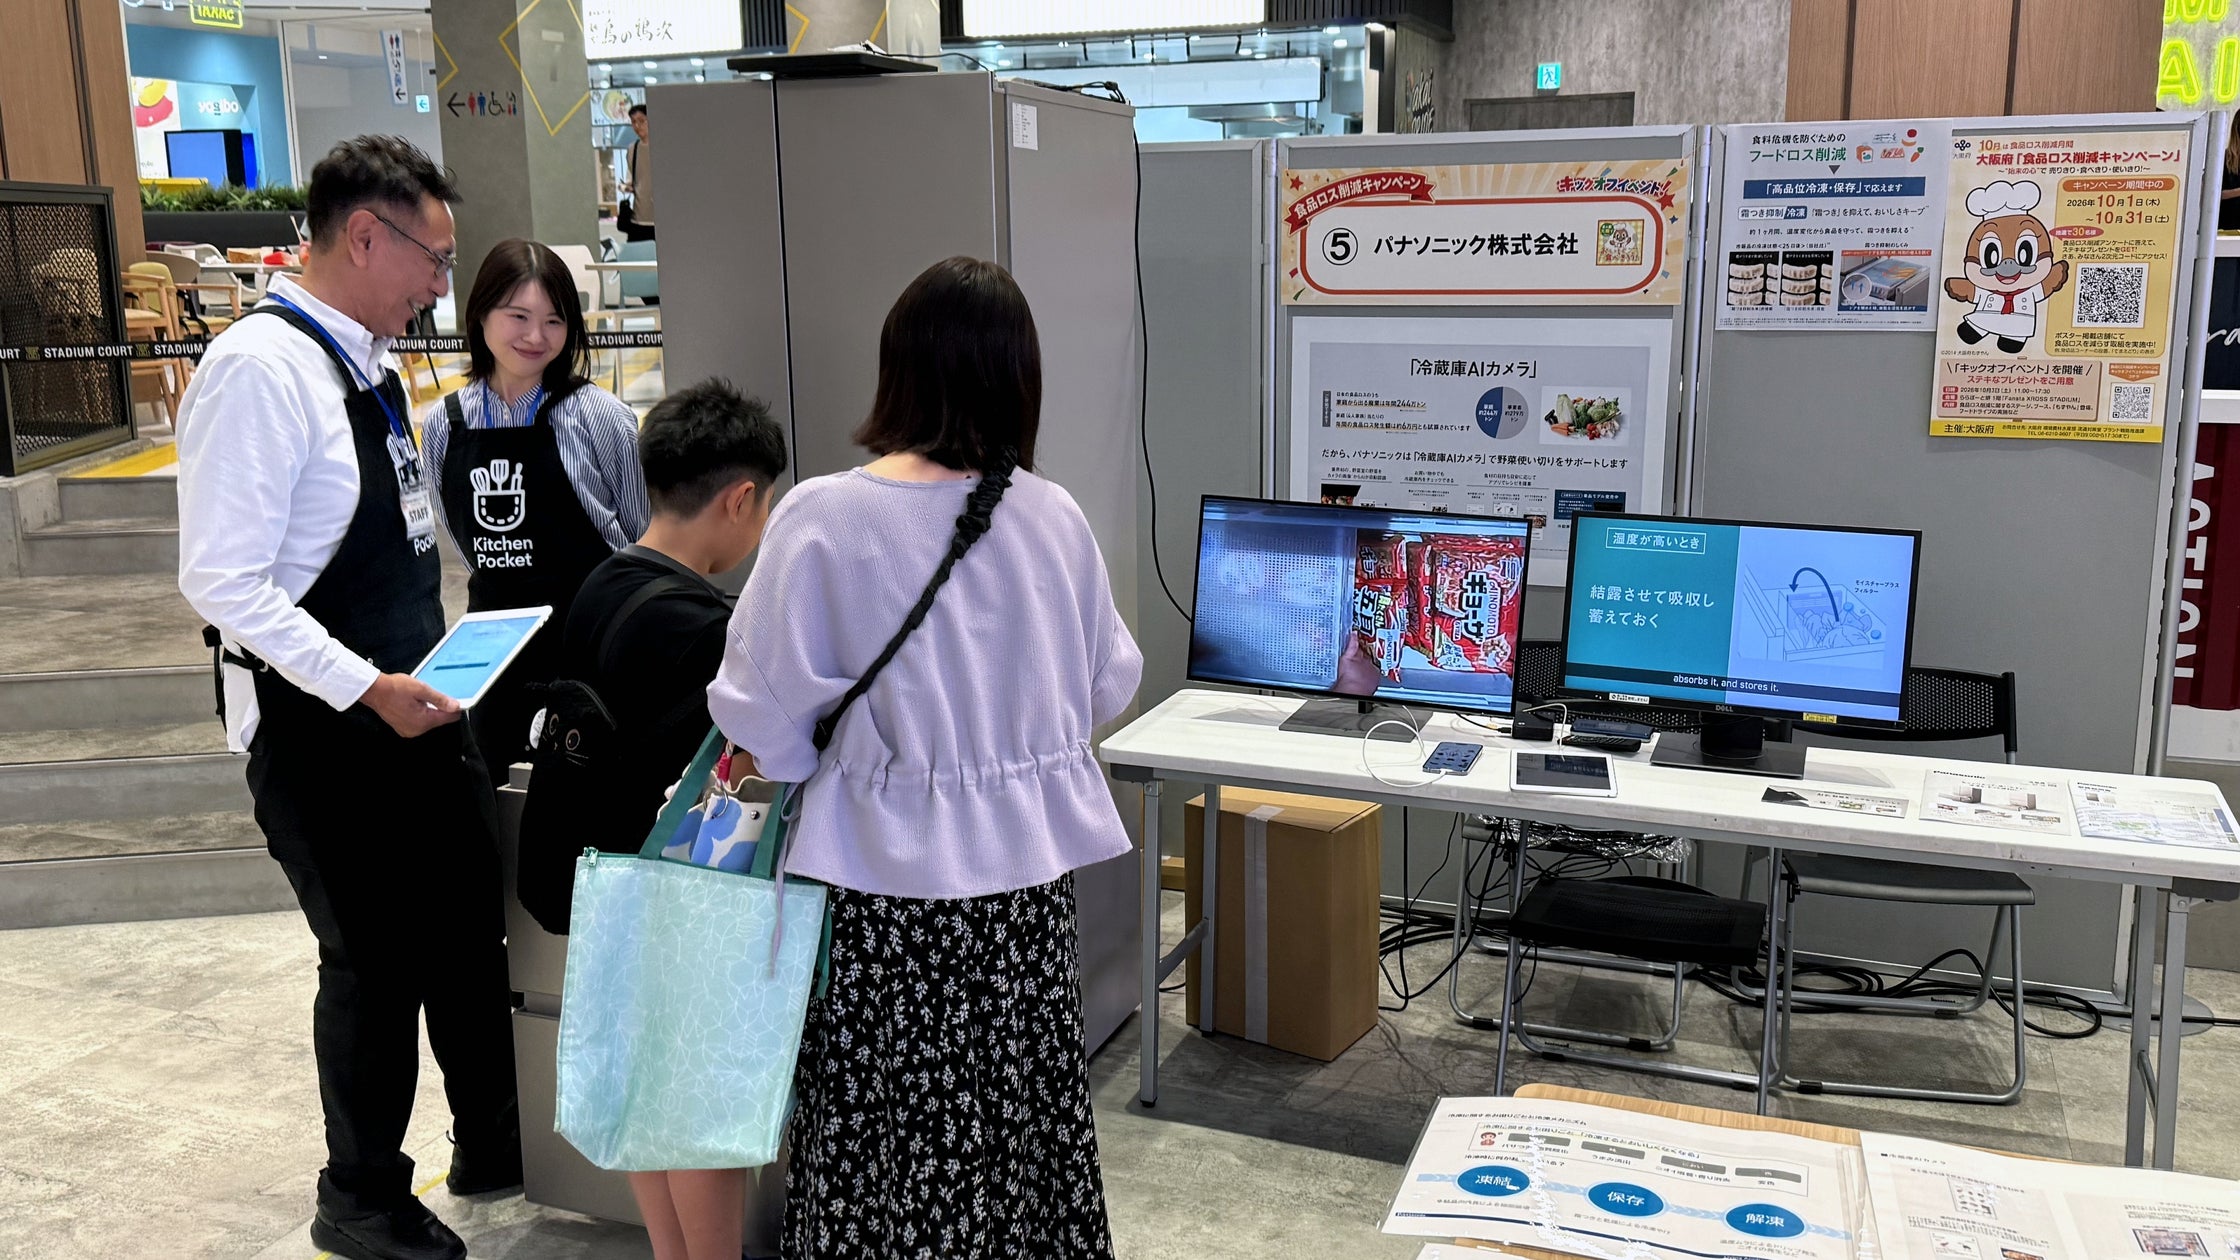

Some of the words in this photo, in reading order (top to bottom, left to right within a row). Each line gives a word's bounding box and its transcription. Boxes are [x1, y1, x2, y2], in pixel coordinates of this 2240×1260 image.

[1752, 133, 1846, 145] 食料危機を防ぐための
[1750, 147, 1847, 162] フードロス削減
[1976, 149, 2181, 166] 大阪府「食品ロス削減キャンペーン」
[1766, 182, 1903, 195] 「高品位冷凍・保存」で応えます
[2073, 180, 2164, 191] キャンペーン期間中の
[1294, 176, 1421, 219] 食品ロス削減キャンペーン
[1373, 232, 1579, 257] パナソニック株式会社
[390, 338, 427, 350] ADIUM
[430, 338, 465, 350] COURT
[588, 334, 634, 346] STADIUM
[44, 347, 95, 359] STADIUM
[98, 345, 134, 358] COURT
[154, 343, 204, 356] STADIUM
[1410, 358, 1537, 379] 「冷蔵庫AIカメラ」
[1967, 375, 2075, 385] ステキなプレゼントをご用意
[408, 506, 429, 523] STAFF
[473, 536, 534, 552] Kitchen
[477, 552, 533, 569] Pocket
[1589, 584, 1715, 608] 結露させて吸収し
[1464, 574, 1488, 643] ギョーザ
[1486, 581, 1499, 635] AJINOMOTO
[1588, 608, 1660, 628] 蓄えておく
[1673, 674, 1709, 686] absorbs
[1711, 676, 1720, 687] it,
[1721, 678, 1738, 688] and
[1740, 680, 1768, 692] stores
[1770, 683, 1780, 692] it.
[1715, 704, 1735, 713] DELL
[1475, 1174, 1512, 1189] 凍結
[1607, 1191, 1646, 1206] 保存
[1745, 1213, 1785, 1227] 解凍
